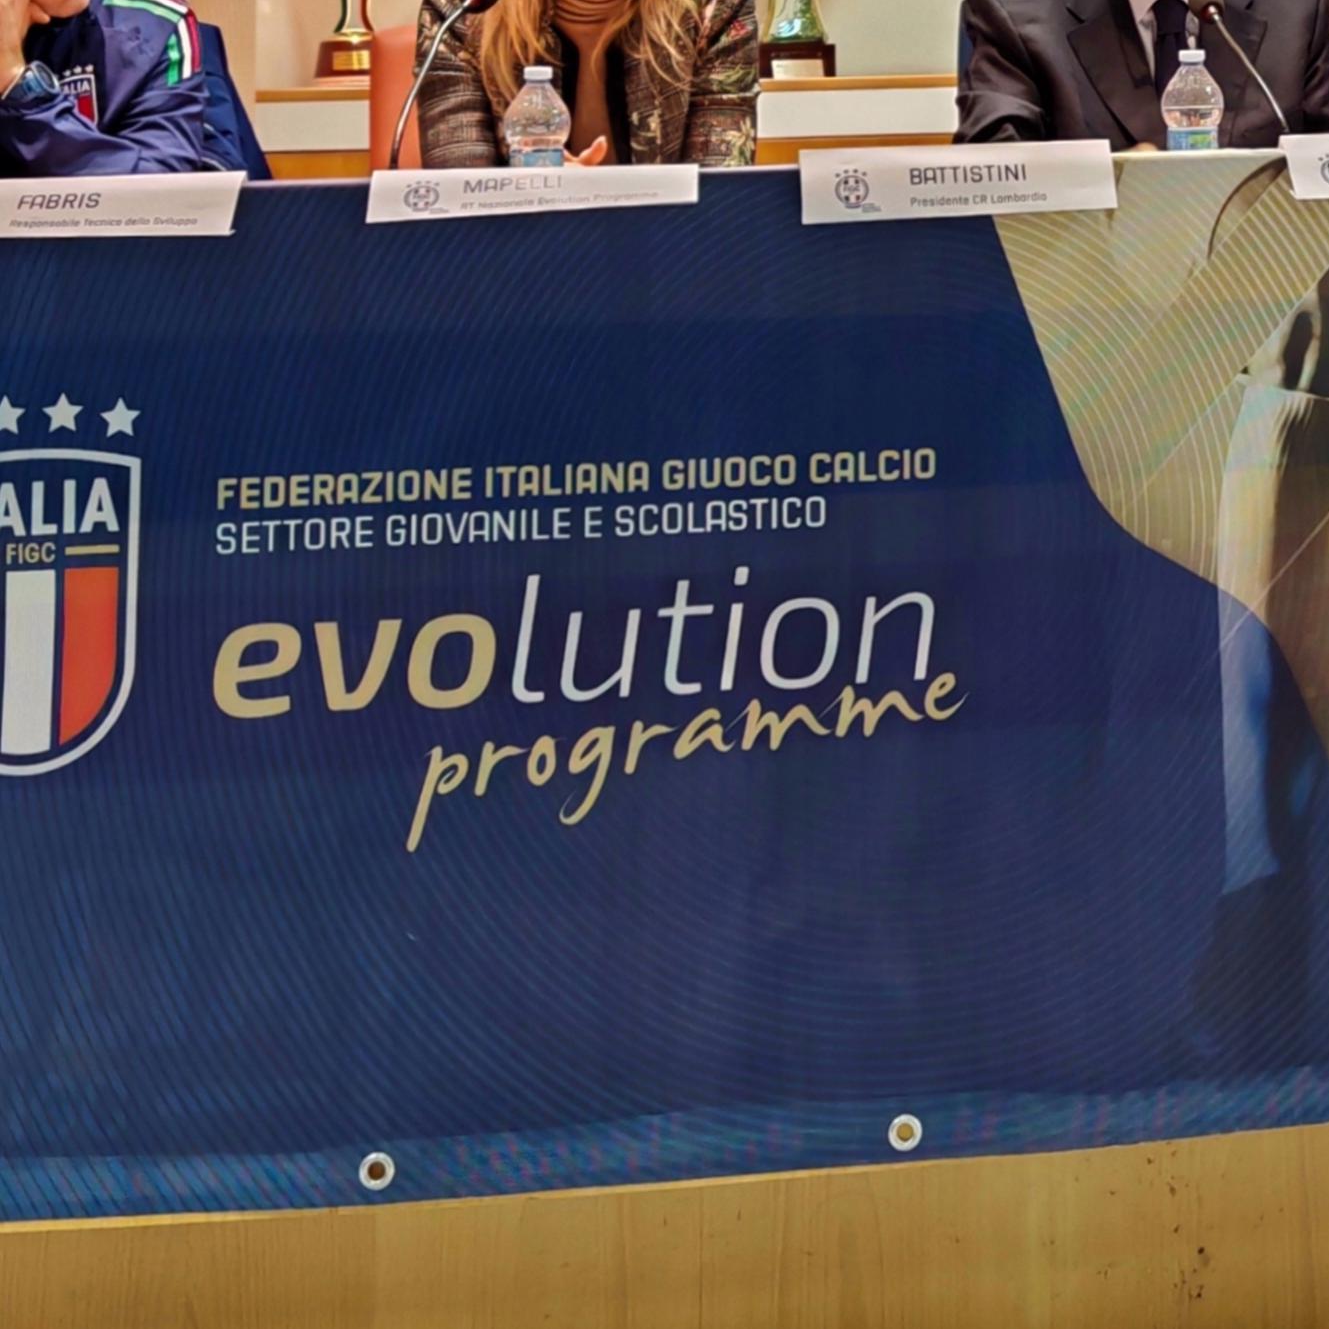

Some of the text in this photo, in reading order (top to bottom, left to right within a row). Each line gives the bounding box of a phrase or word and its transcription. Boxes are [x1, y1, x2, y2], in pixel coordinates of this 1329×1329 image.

[62, 80, 91, 95] ALIA
[463, 174, 563, 194] MAPELLI
[909, 163, 1028, 186] BATTISTINI
[17, 192, 102, 211] FABRIS
[909, 191, 1048, 208] Presidente CR Lombardia
[216, 447, 938, 511] FEDERAZIONE ITALIANA GIUOCO CALCIO
[0, 476, 121, 537] ALIA
[215, 494, 828, 556] SETTORE GIOVANILE E SCOLASTICO
[5, 541, 57, 566] FIGC
[211, 565, 936, 720] evolution
[405, 670, 971, 853] programme
